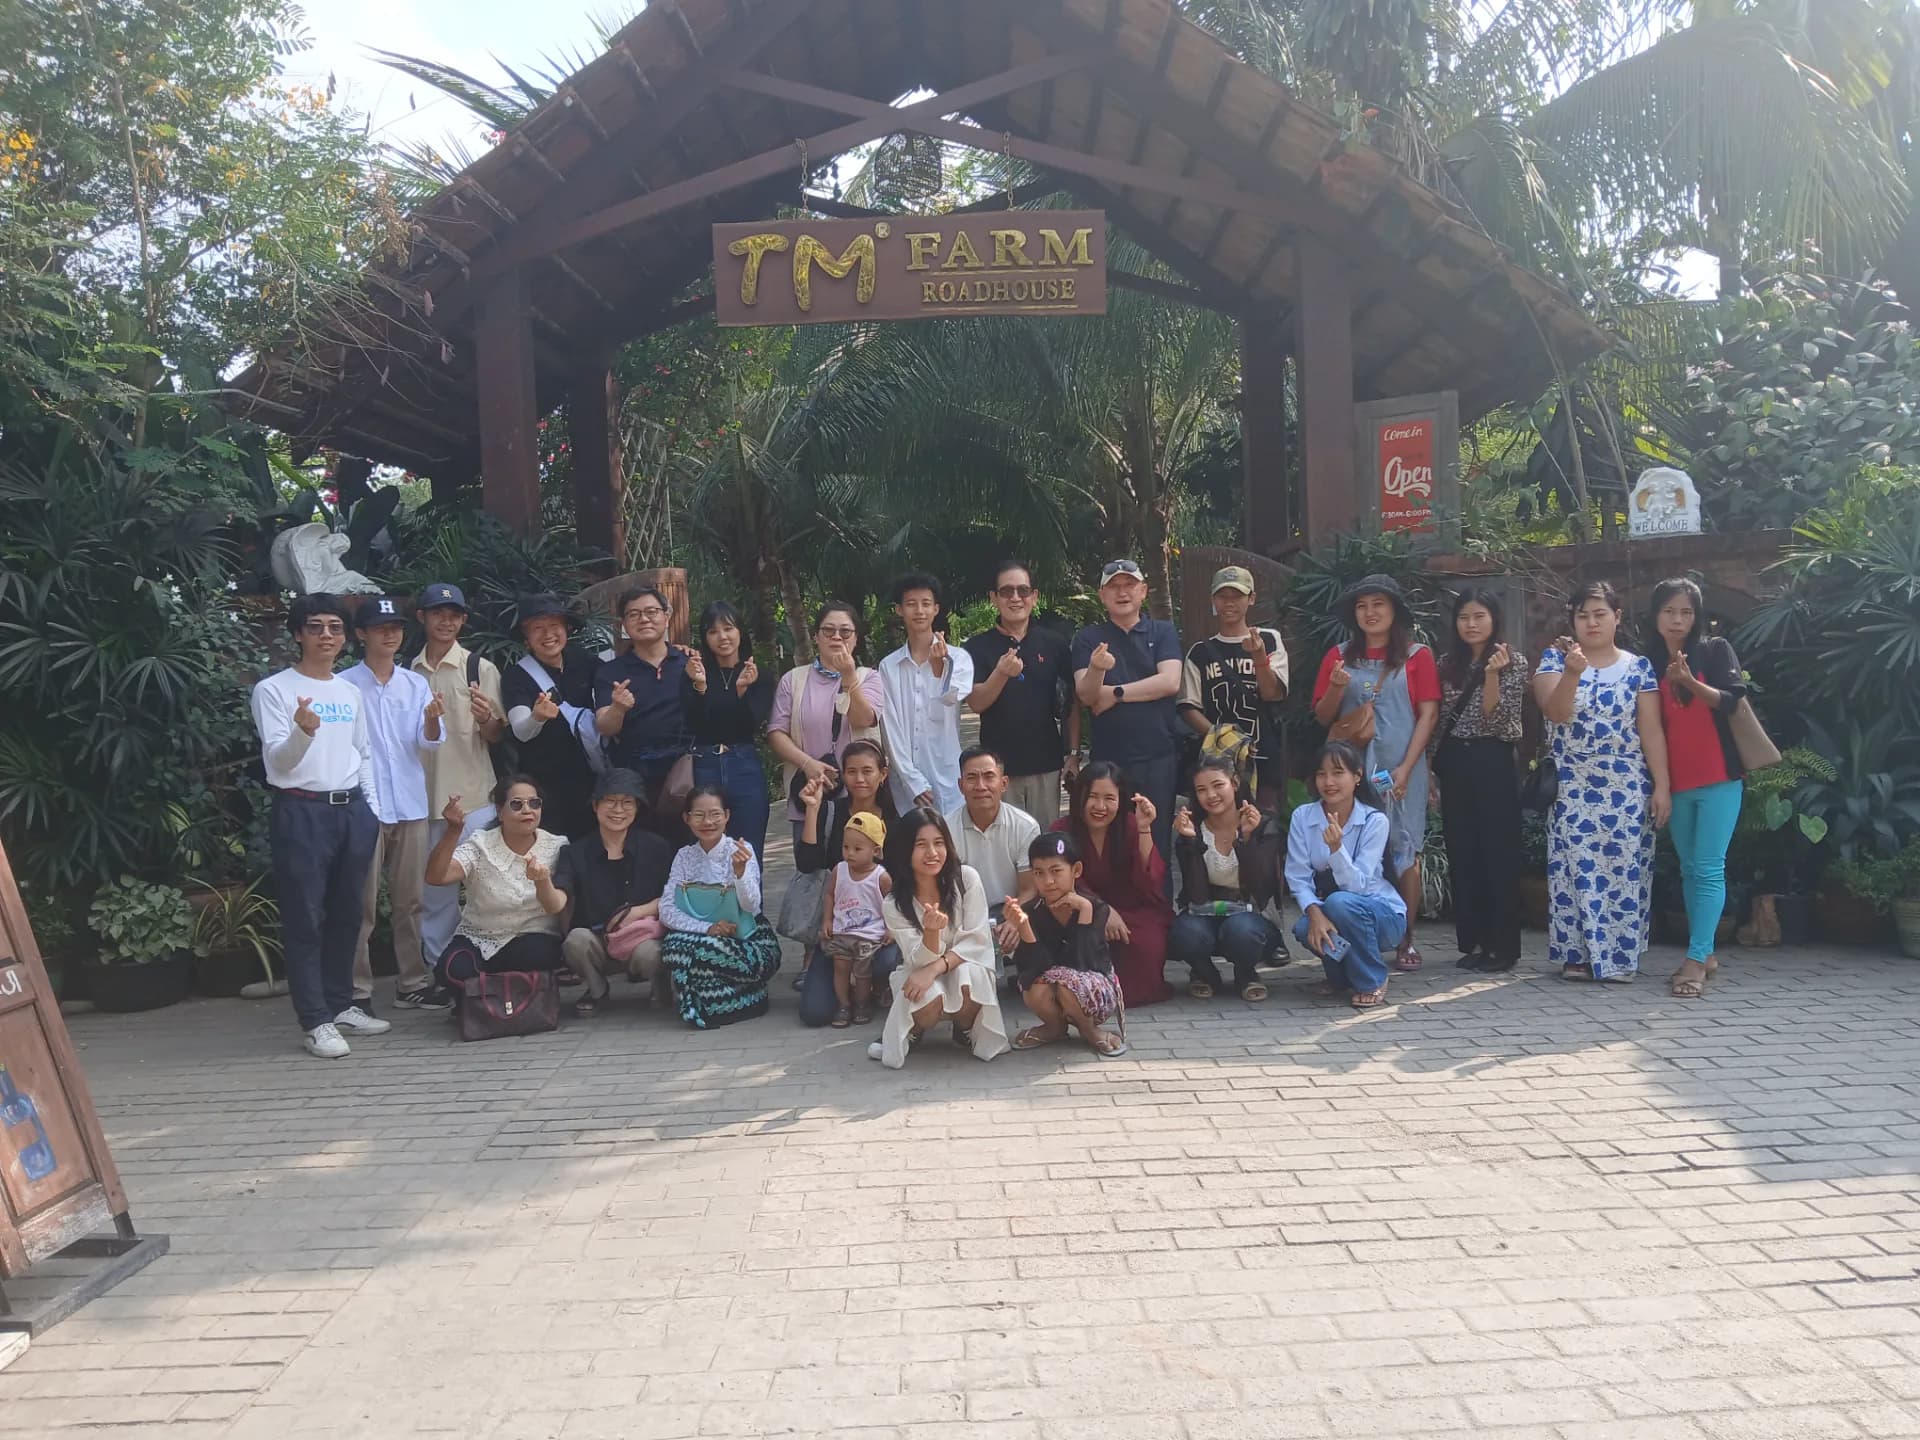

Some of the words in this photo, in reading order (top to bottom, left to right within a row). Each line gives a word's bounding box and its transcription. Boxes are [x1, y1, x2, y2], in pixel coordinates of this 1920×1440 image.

[905, 228, 1095, 271] FARM
[922, 278, 1076, 304] ROADHOUSE
[1384, 456, 1433, 497] Open
[1634, 519, 1689, 533] WELCOME
[378, 600, 395, 614] H
